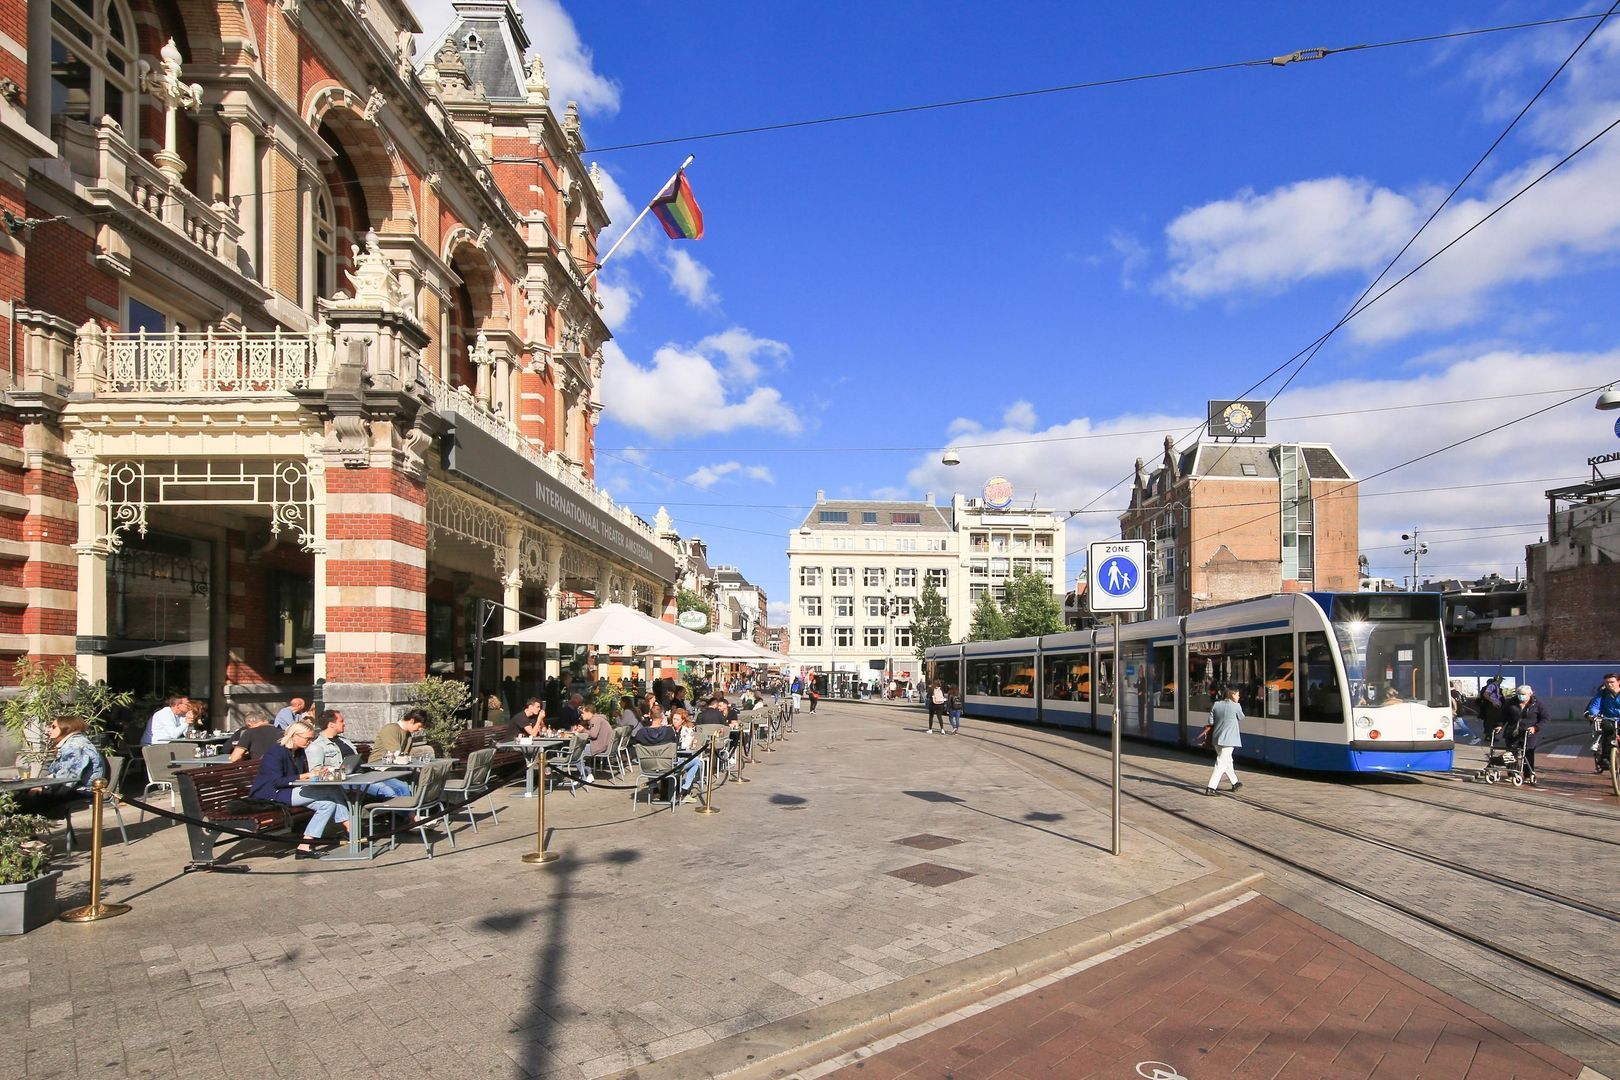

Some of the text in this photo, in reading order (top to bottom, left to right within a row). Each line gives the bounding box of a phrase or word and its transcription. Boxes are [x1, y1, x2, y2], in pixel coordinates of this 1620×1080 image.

[535, 480, 600, 534] INTERNATIONAAL
[601, 522, 624, 546] THEATER
[1105, 545, 1130, 553] ZONE
